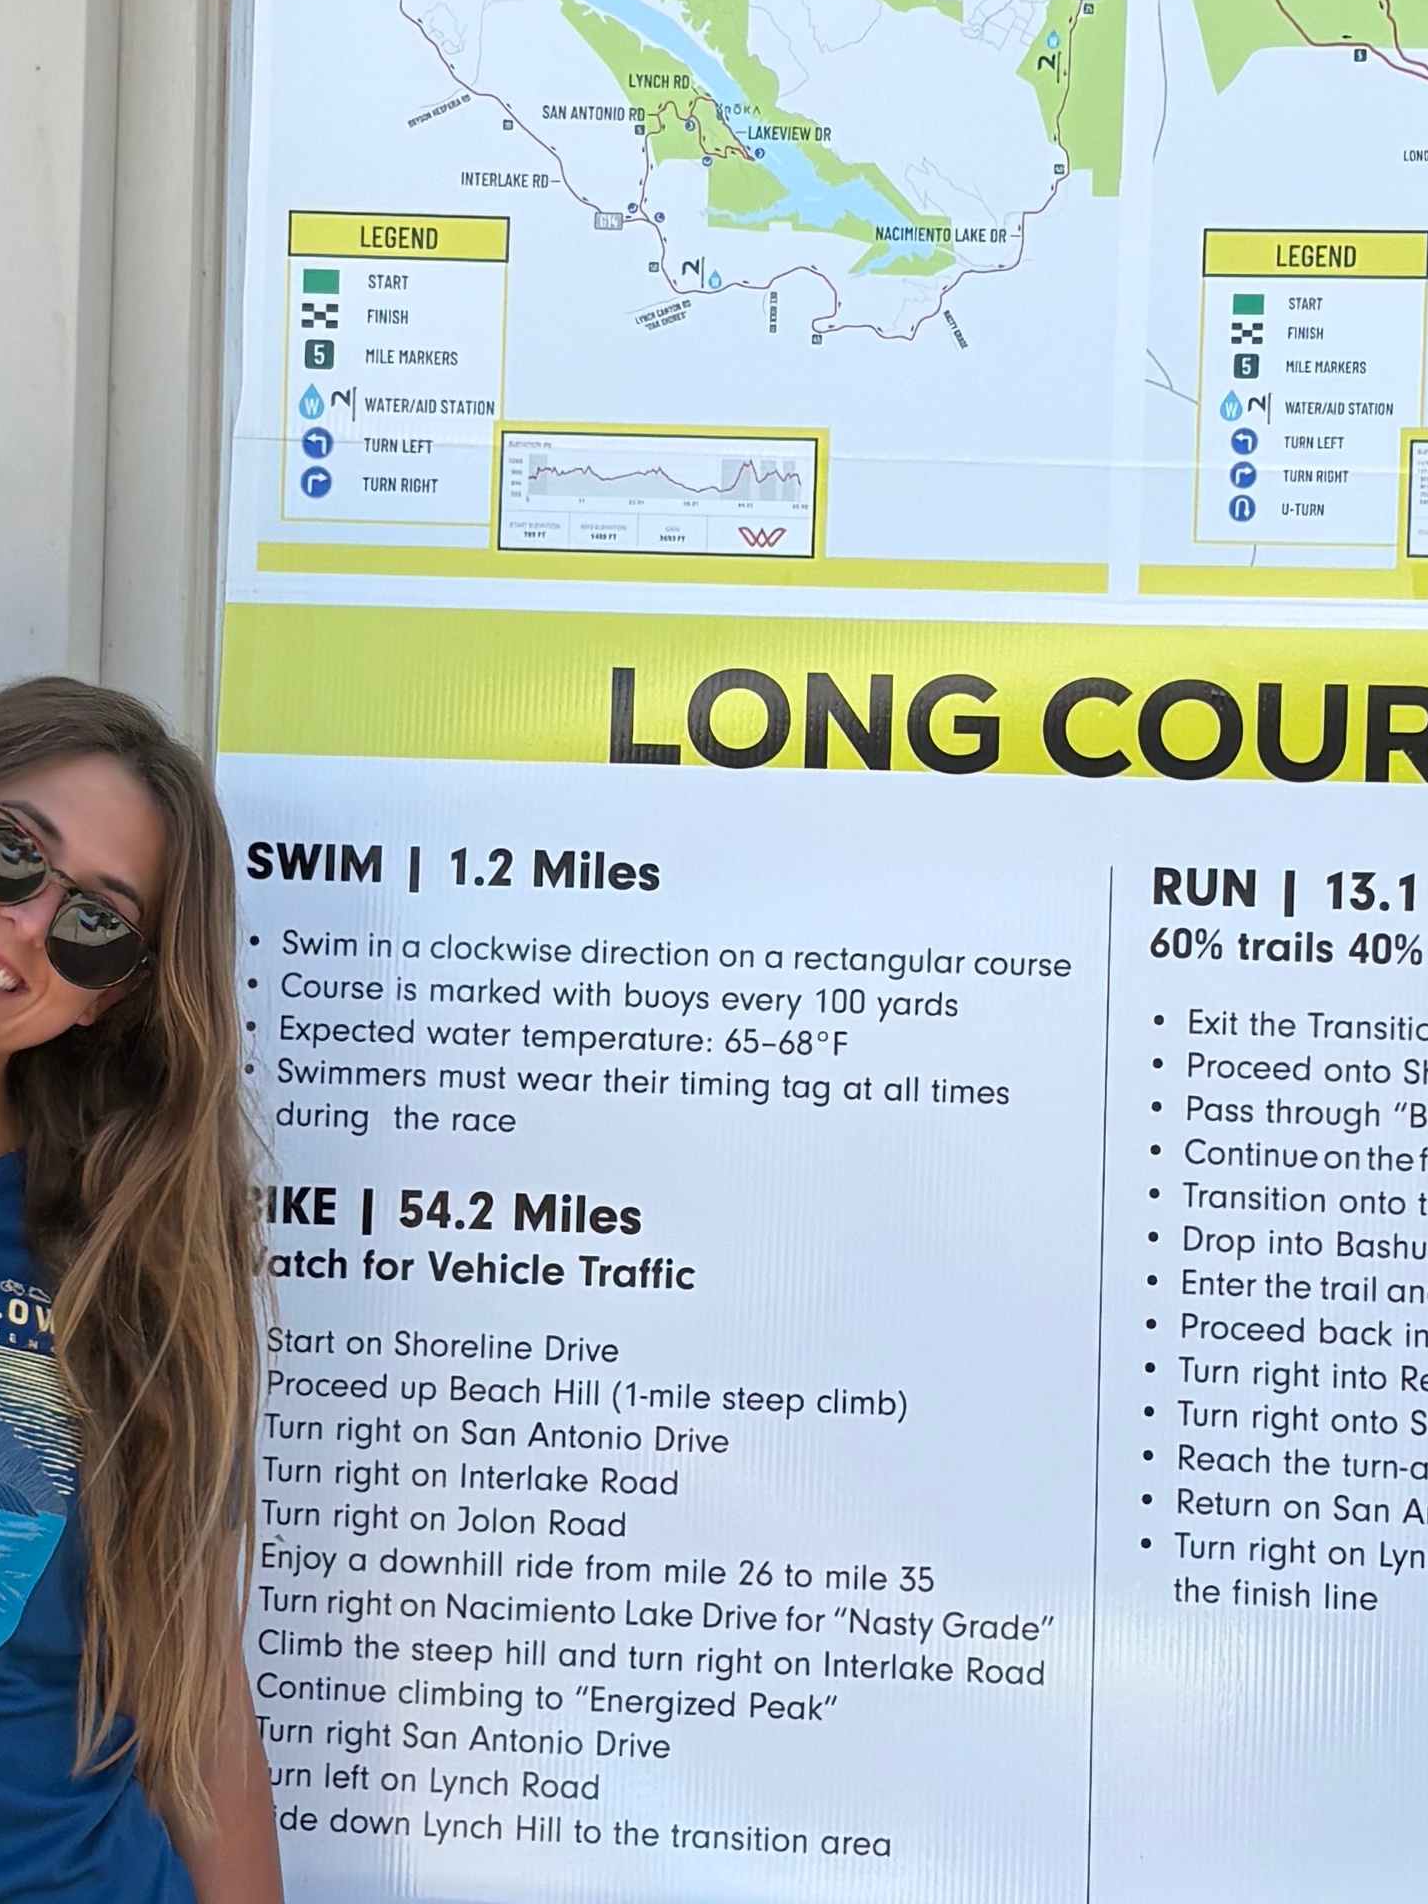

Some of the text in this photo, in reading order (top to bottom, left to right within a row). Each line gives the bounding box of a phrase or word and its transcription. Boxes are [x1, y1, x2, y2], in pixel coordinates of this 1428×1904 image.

[361, 226, 437, 249] LEGEND
[876, 226, 1006, 243] NACIMIENTO LAKE DR
[369, 275, 408, 289] START
[368, 309, 408, 324] FINISH
[365, 348, 459, 366] MILE MARKERS
[365, 398, 494, 415] WATER/AID STATION
[364, 438, 432, 453] TURN LEFT
[363, 477, 438, 492] TURN RIGHT
[610, 667, 1000, 774] LONG
[247, 842, 659, 891] SWIM 1.2 Miles
[1154, 867, 1256, 907] RUN
[1327, 872, 1415, 911] 13.1
[283, 930, 1071, 980] Swim in a clockwise direction on a rectangular course
[1151, 928, 1222, 959] 60%
[1238, 932, 1333, 963] trails
[1349, 933, 1422, 965] 40%
[281, 1015, 414, 1048] Expected
[427, 1023, 511, 1046] water
[522, 1025, 712, 1056] temperature:
[1189, 1009, 1237, 1035] Exit
[1250, 1011, 1296, 1037] the
[400, 1190, 493, 1229] 54.2
[515, 1193, 641, 1235] Miles
[363, 1249, 414, 1280] for
[428, 1251, 564, 1285] Vehicle
[579, 1256, 695, 1289] Traffic
[268, 1327, 618, 1362] Start on Shoreline Drive
[264, 1413, 728, 1453] Turn right on San Antonio Drive
[1178, 1488, 1269, 1517] Return
[1284, 1500, 1319, 1519] on
[1334, 1495, 1389, 1522] San
